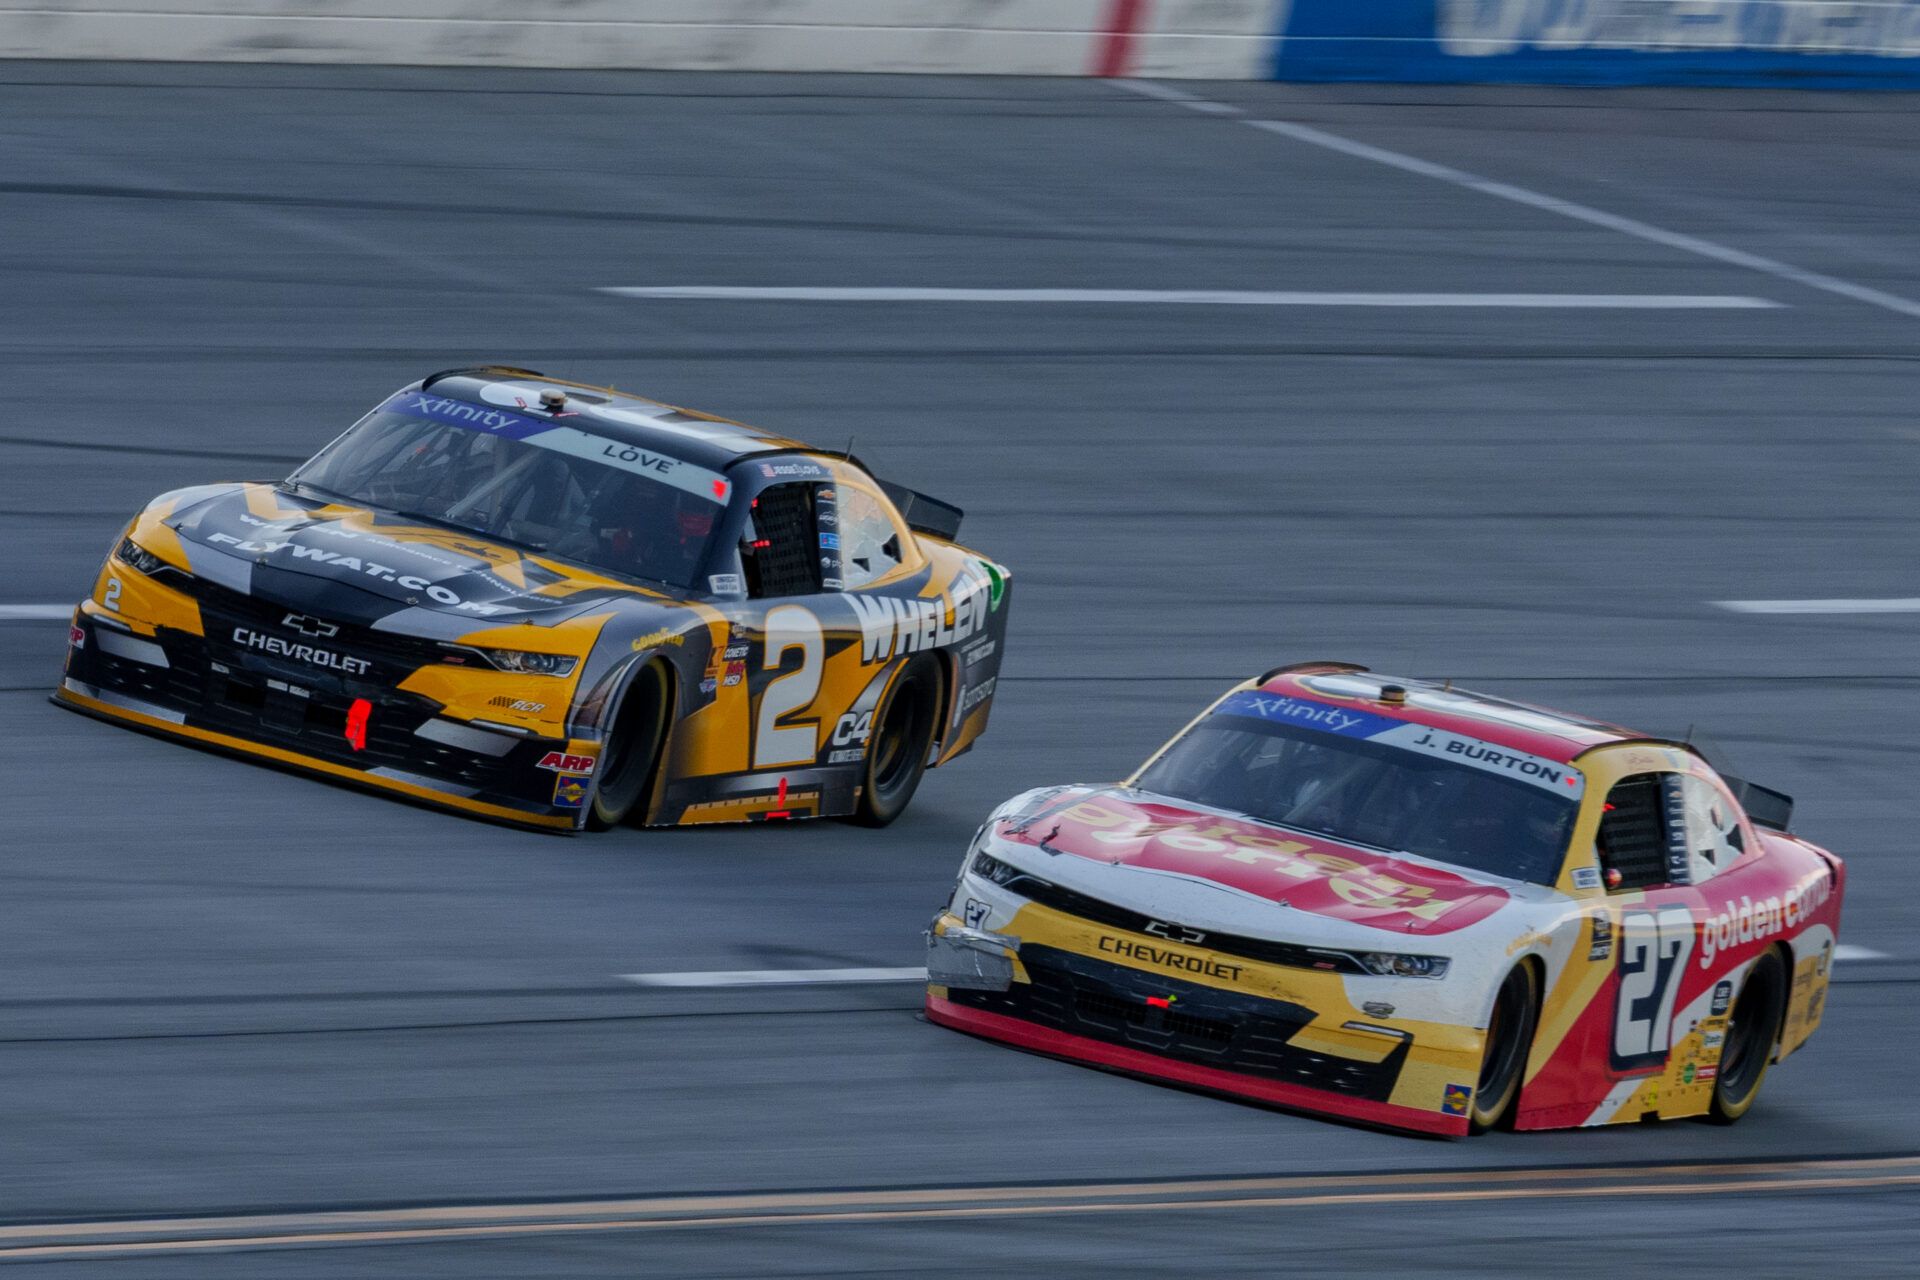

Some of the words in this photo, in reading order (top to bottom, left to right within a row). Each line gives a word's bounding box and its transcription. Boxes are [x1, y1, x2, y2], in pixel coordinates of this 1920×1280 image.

[410, 394, 520, 432] xfinity
[603, 445, 673, 475] LOVE
[104, 577, 122, 612] 2
[206, 531, 501, 616] FLYWAT.COM
[841, 575, 990, 662] WHELEN
[233, 627, 374, 676] CHEVROLET
[509, 700, 546, 713] RCR
[755, 604, 825, 769] 2
[832, 710, 874, 746] C4
[1246, 696, 1362, 731] xfinity
[539, 752, 595, 773] ARP
[1412, 733, 1437, 750] J.
[1444, 739, 1561, 785] BURTON
[964, 898, 993, 931] 27
[1700, 896, 1782, 970] golden
[1098, 935, 1243, 981] CHEVROLET
[1614, 910, 1697, 1058] 27
